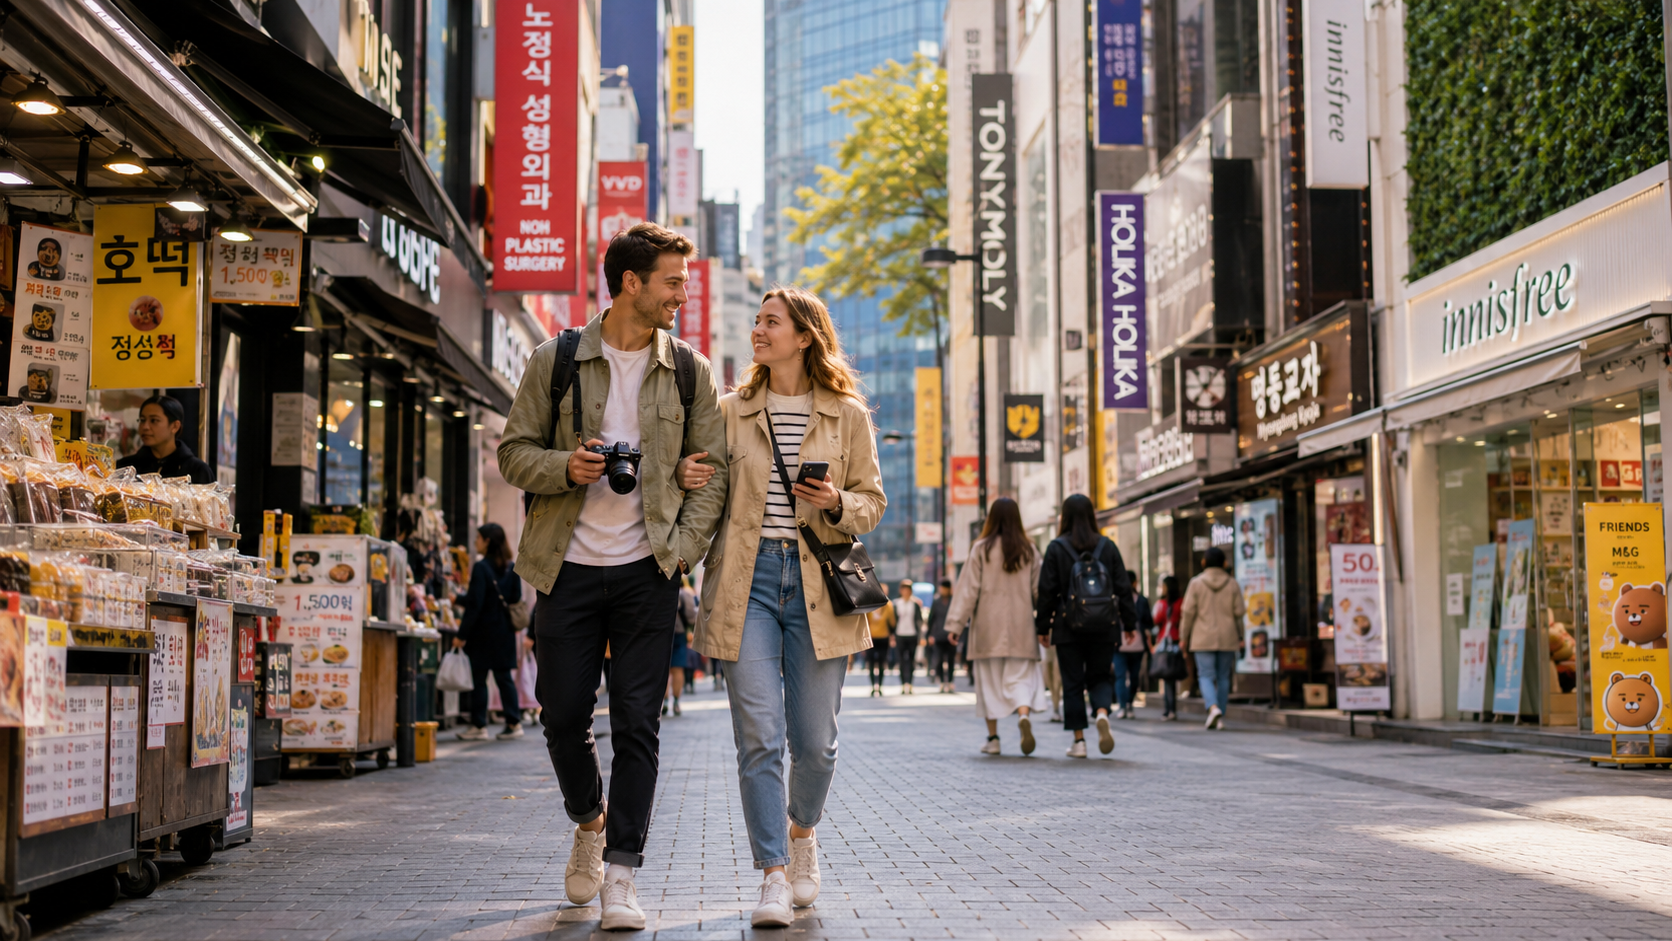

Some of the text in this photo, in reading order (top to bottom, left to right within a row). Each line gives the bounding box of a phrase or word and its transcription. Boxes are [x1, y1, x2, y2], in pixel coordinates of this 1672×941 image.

[520, 2, 554, 211] 노정식 성형외과
[1324, 19, 1351, 143] innisfree
[505, 237, 565, 254] PLASTIC
[519, 219, 551, 235] NOH
[978, 99, 1007, 312] TONYMOLY
[96, 234, 190, 288] 호떡
[504, 255, 566, 271] SURGERY
[1110, 203, 1138, 401] HOLIKA HOLIKA
[1442, 262, 1574, 355] innisfree
[1250, 340, 1321, 420] 명동교자
[1599, 522, 1650, 532] FRIENDS
